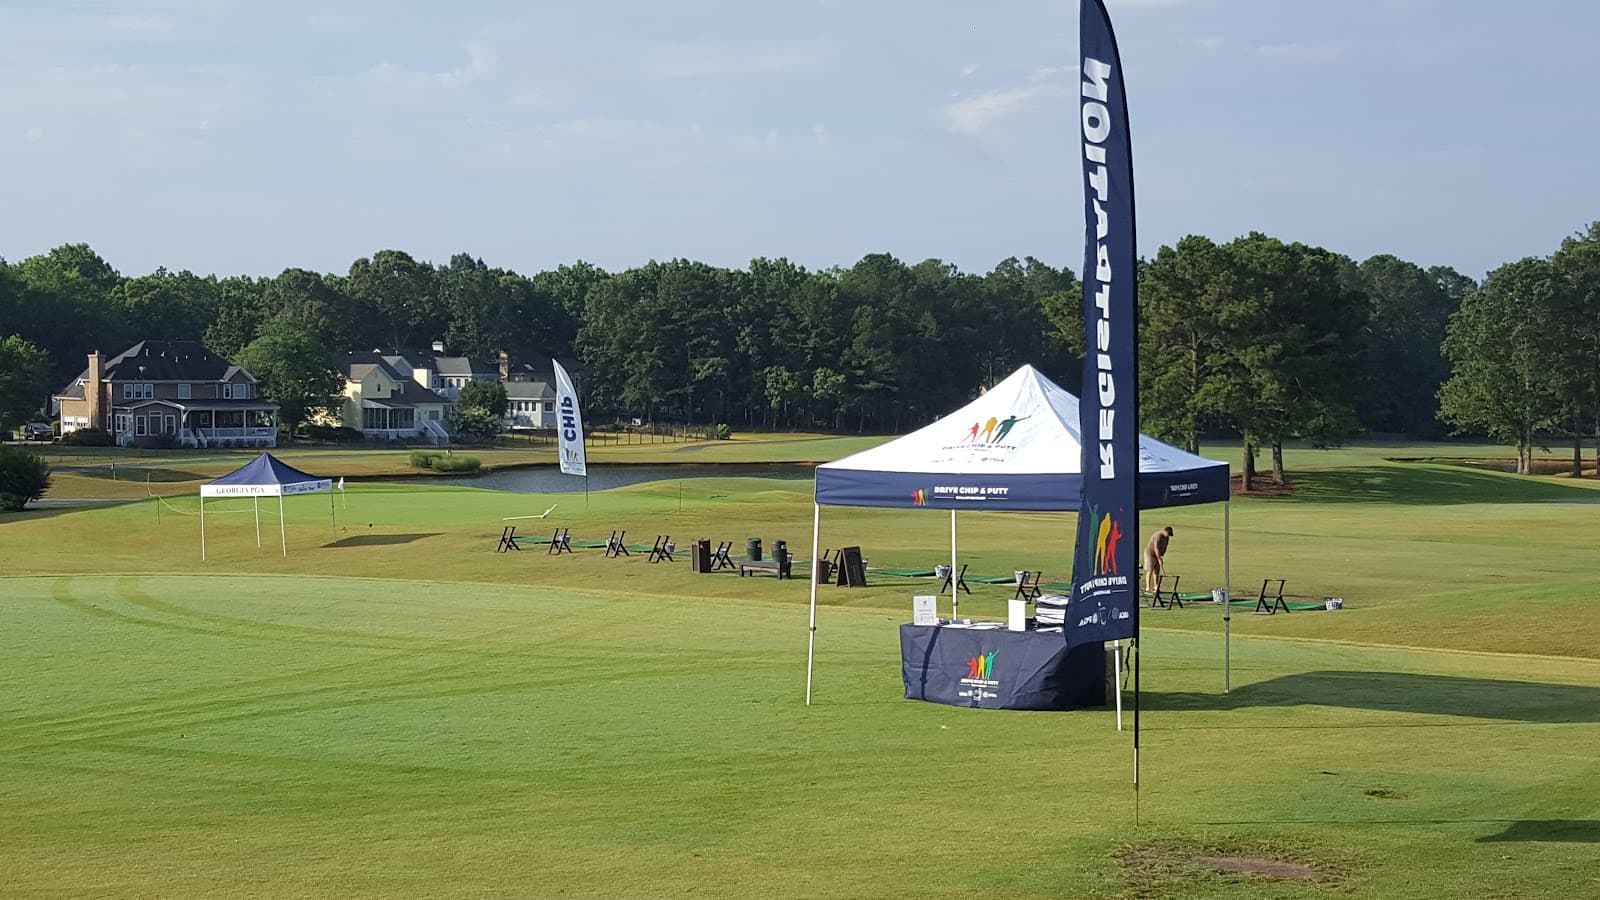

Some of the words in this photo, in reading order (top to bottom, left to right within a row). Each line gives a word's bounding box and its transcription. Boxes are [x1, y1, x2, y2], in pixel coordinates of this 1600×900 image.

[934, 486, 958, 494] DRIVE
[980, 487, 986, 495] &
[987, 487, 1008, 495] PUTT
